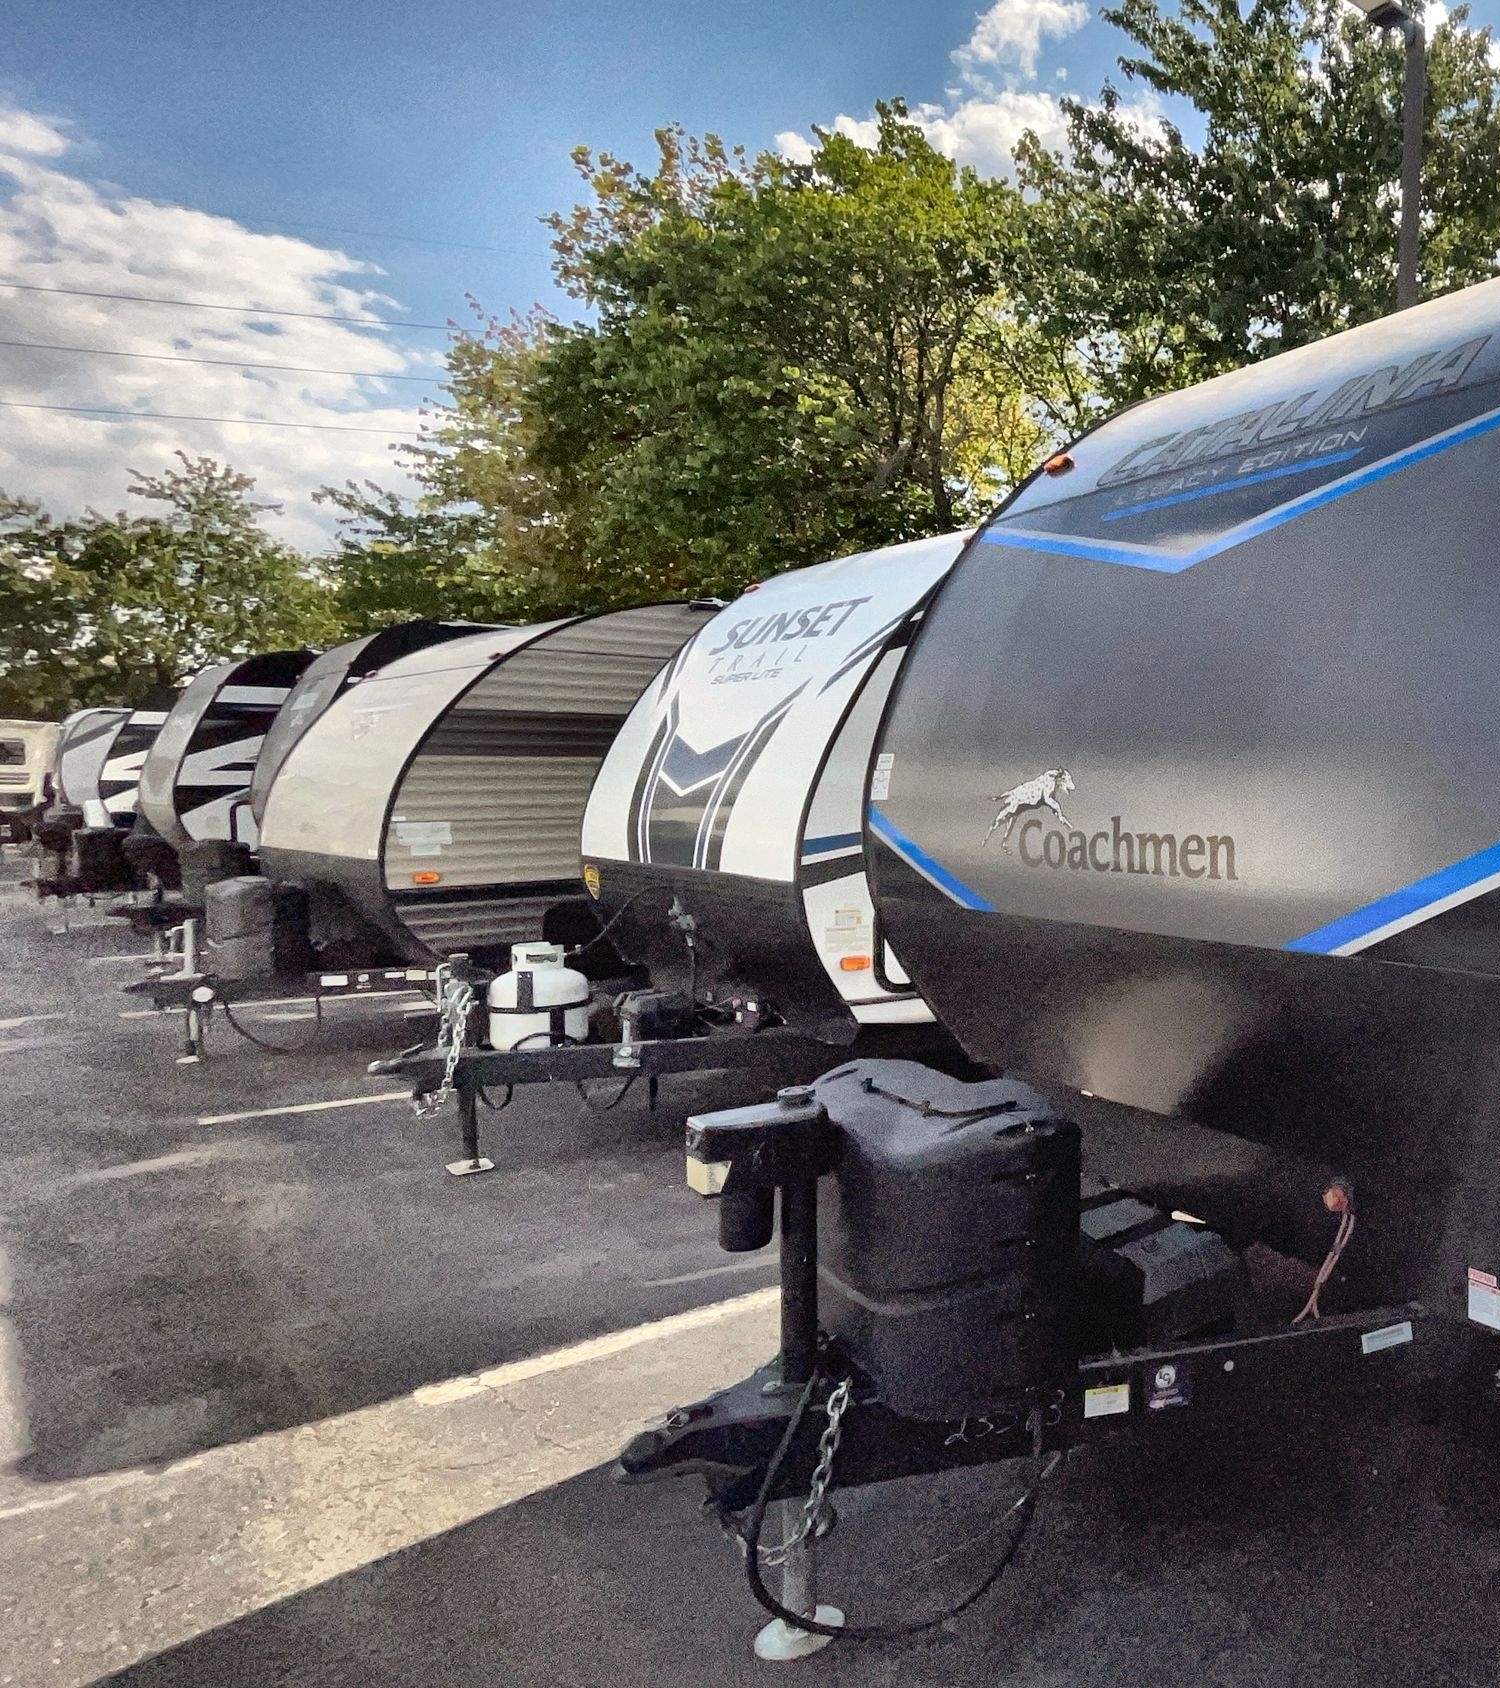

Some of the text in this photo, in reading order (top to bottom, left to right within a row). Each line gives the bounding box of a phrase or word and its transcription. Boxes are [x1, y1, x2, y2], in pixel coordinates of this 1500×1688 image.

[1097, 334, 1493, 487] CATALINA
[1237, 425, 1369, 474] EDITION
[709, 595, 874, 656] SUNSET
[708, 645, 808, 674] TRAIL
[1018, 815, 1239, 881] Coachmen
